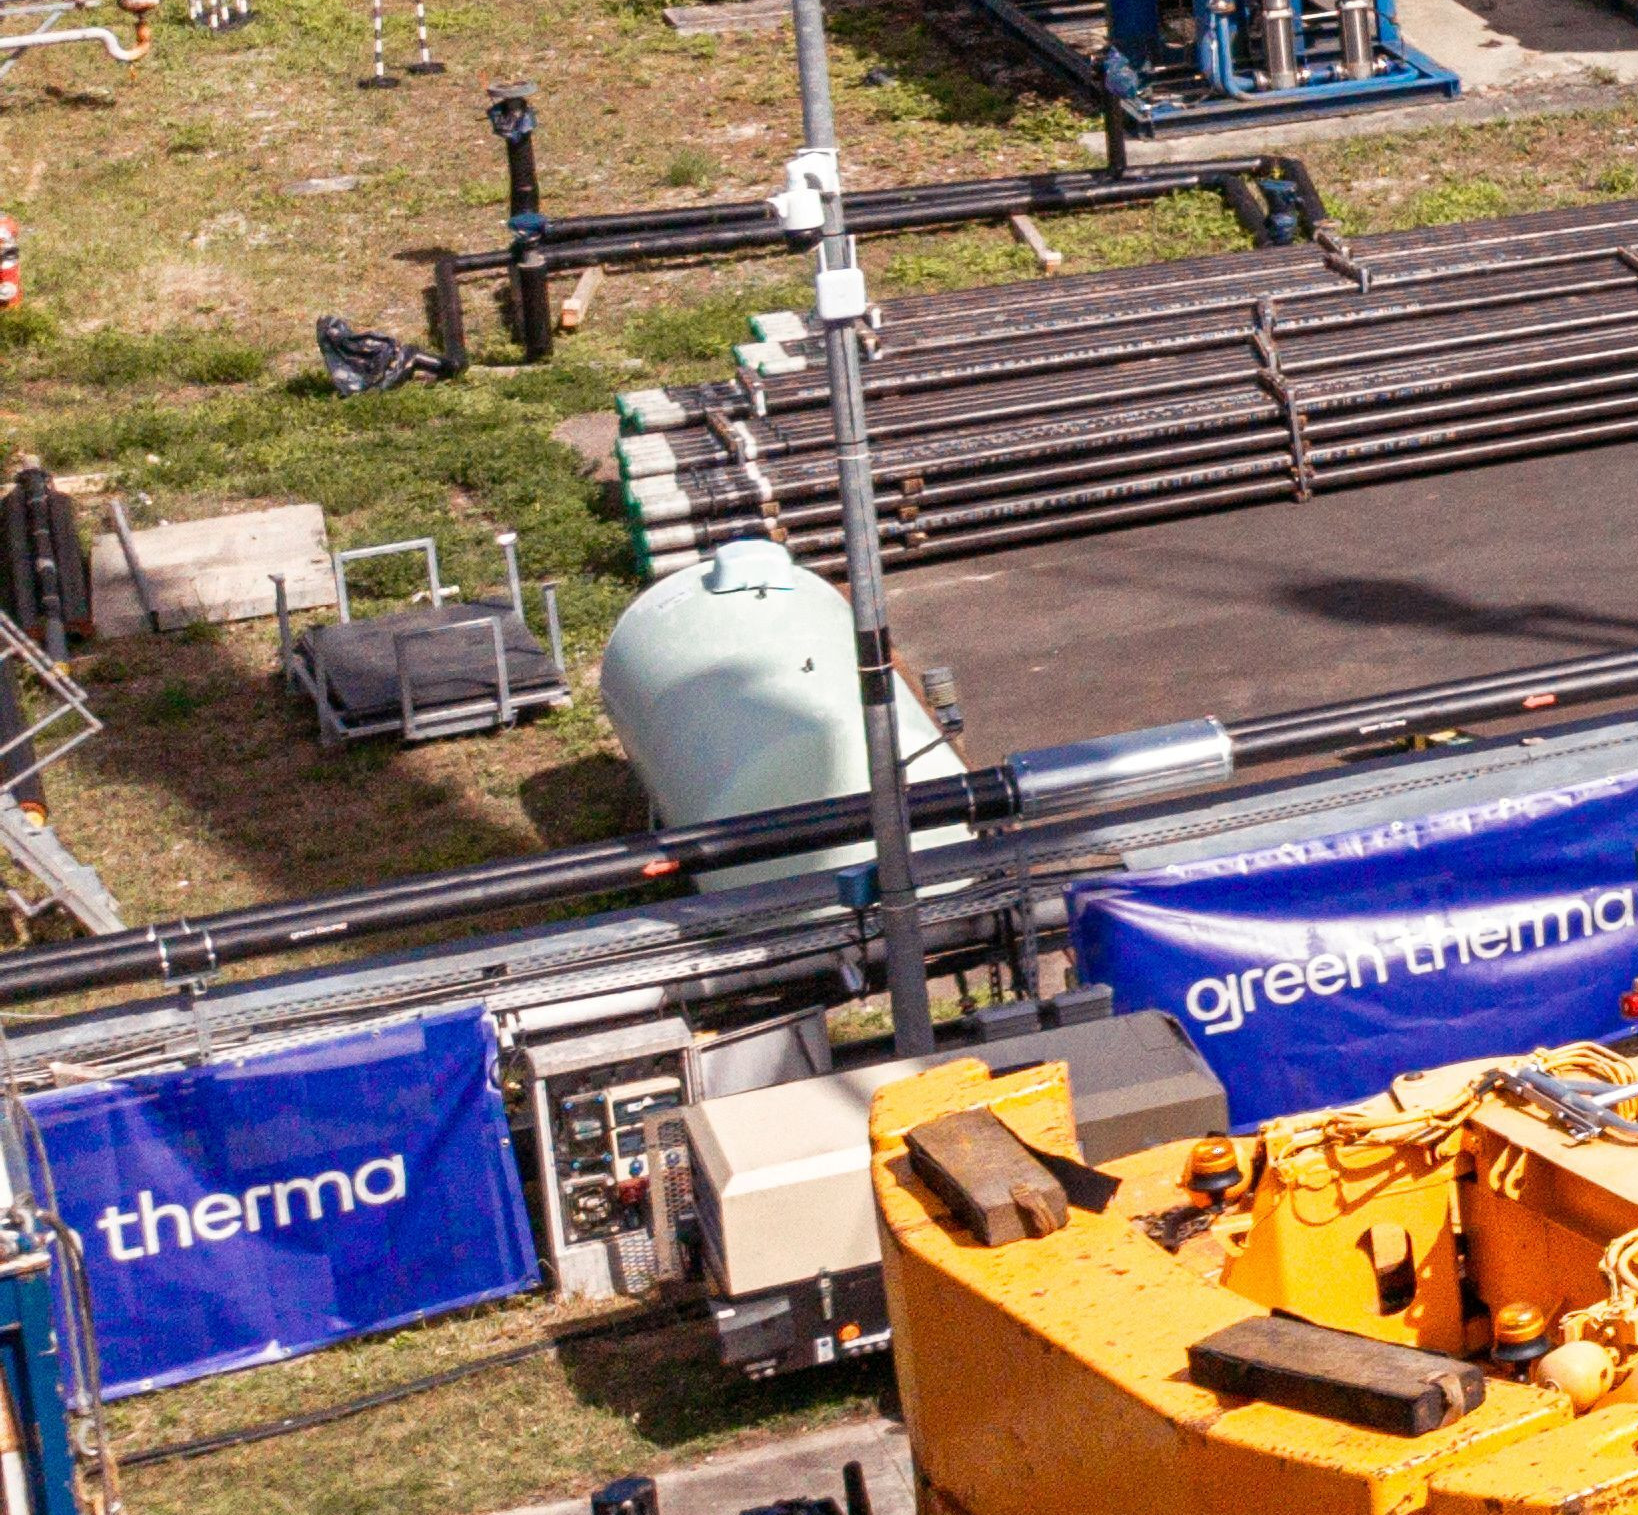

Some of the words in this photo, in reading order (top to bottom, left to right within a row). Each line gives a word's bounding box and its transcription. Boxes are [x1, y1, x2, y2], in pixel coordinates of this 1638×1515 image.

[1184, 934, 1387, 1035] green
[1390, 886, 1635, 974] therma
[98, 1154, 407, 1261] therma
